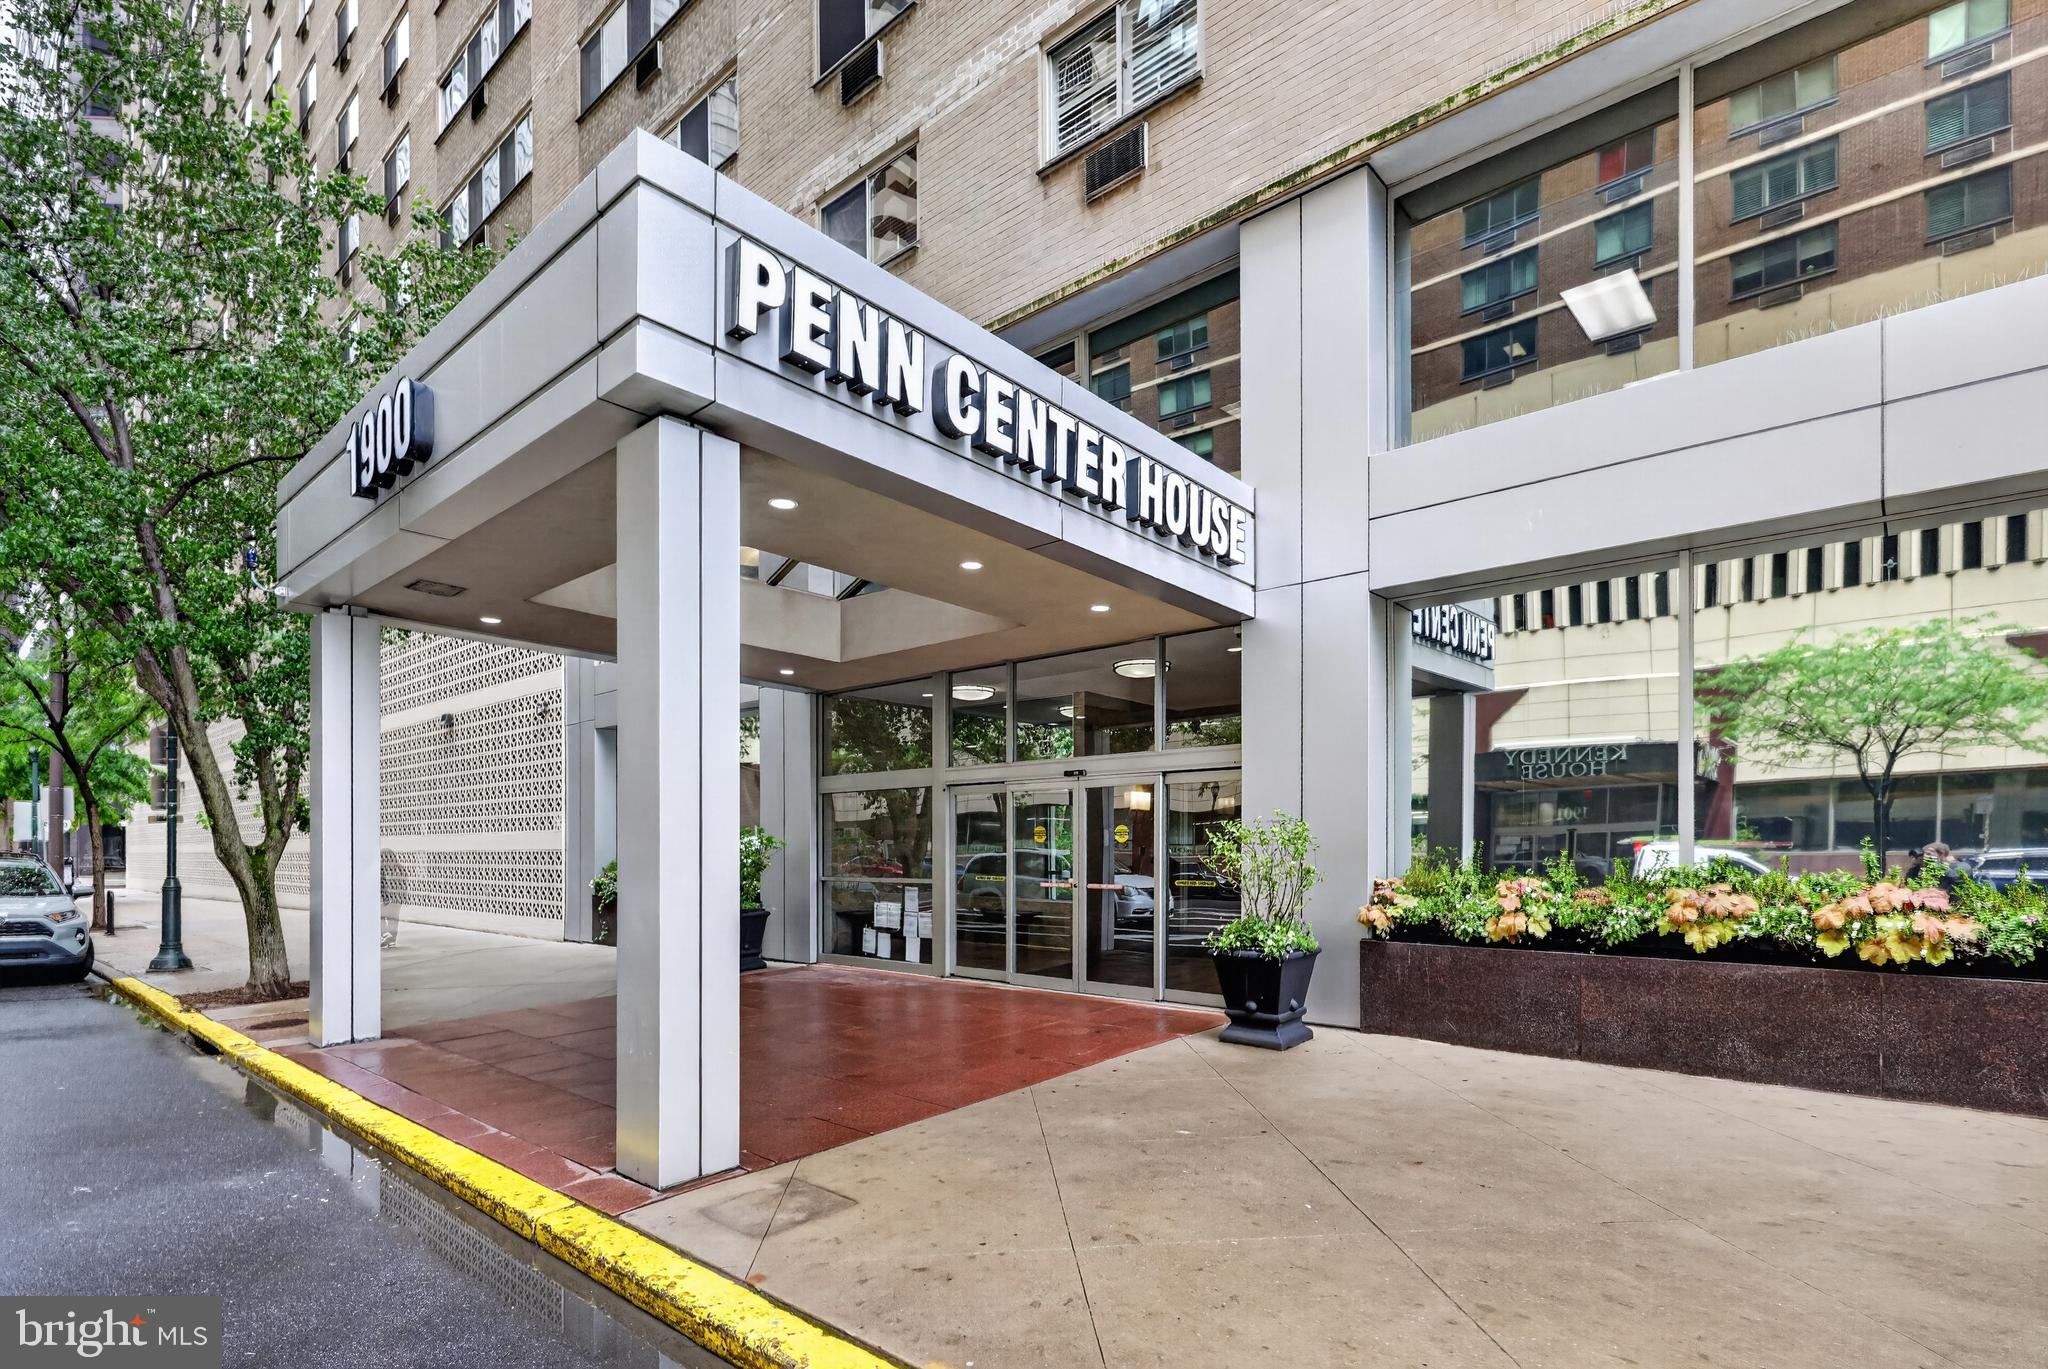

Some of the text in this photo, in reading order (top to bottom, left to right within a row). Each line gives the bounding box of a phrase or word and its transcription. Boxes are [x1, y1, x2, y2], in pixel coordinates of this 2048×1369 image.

[346, 375, 412, 497] 1900
[733, 235, 1247, 566] PENN CENTER HOUSE
